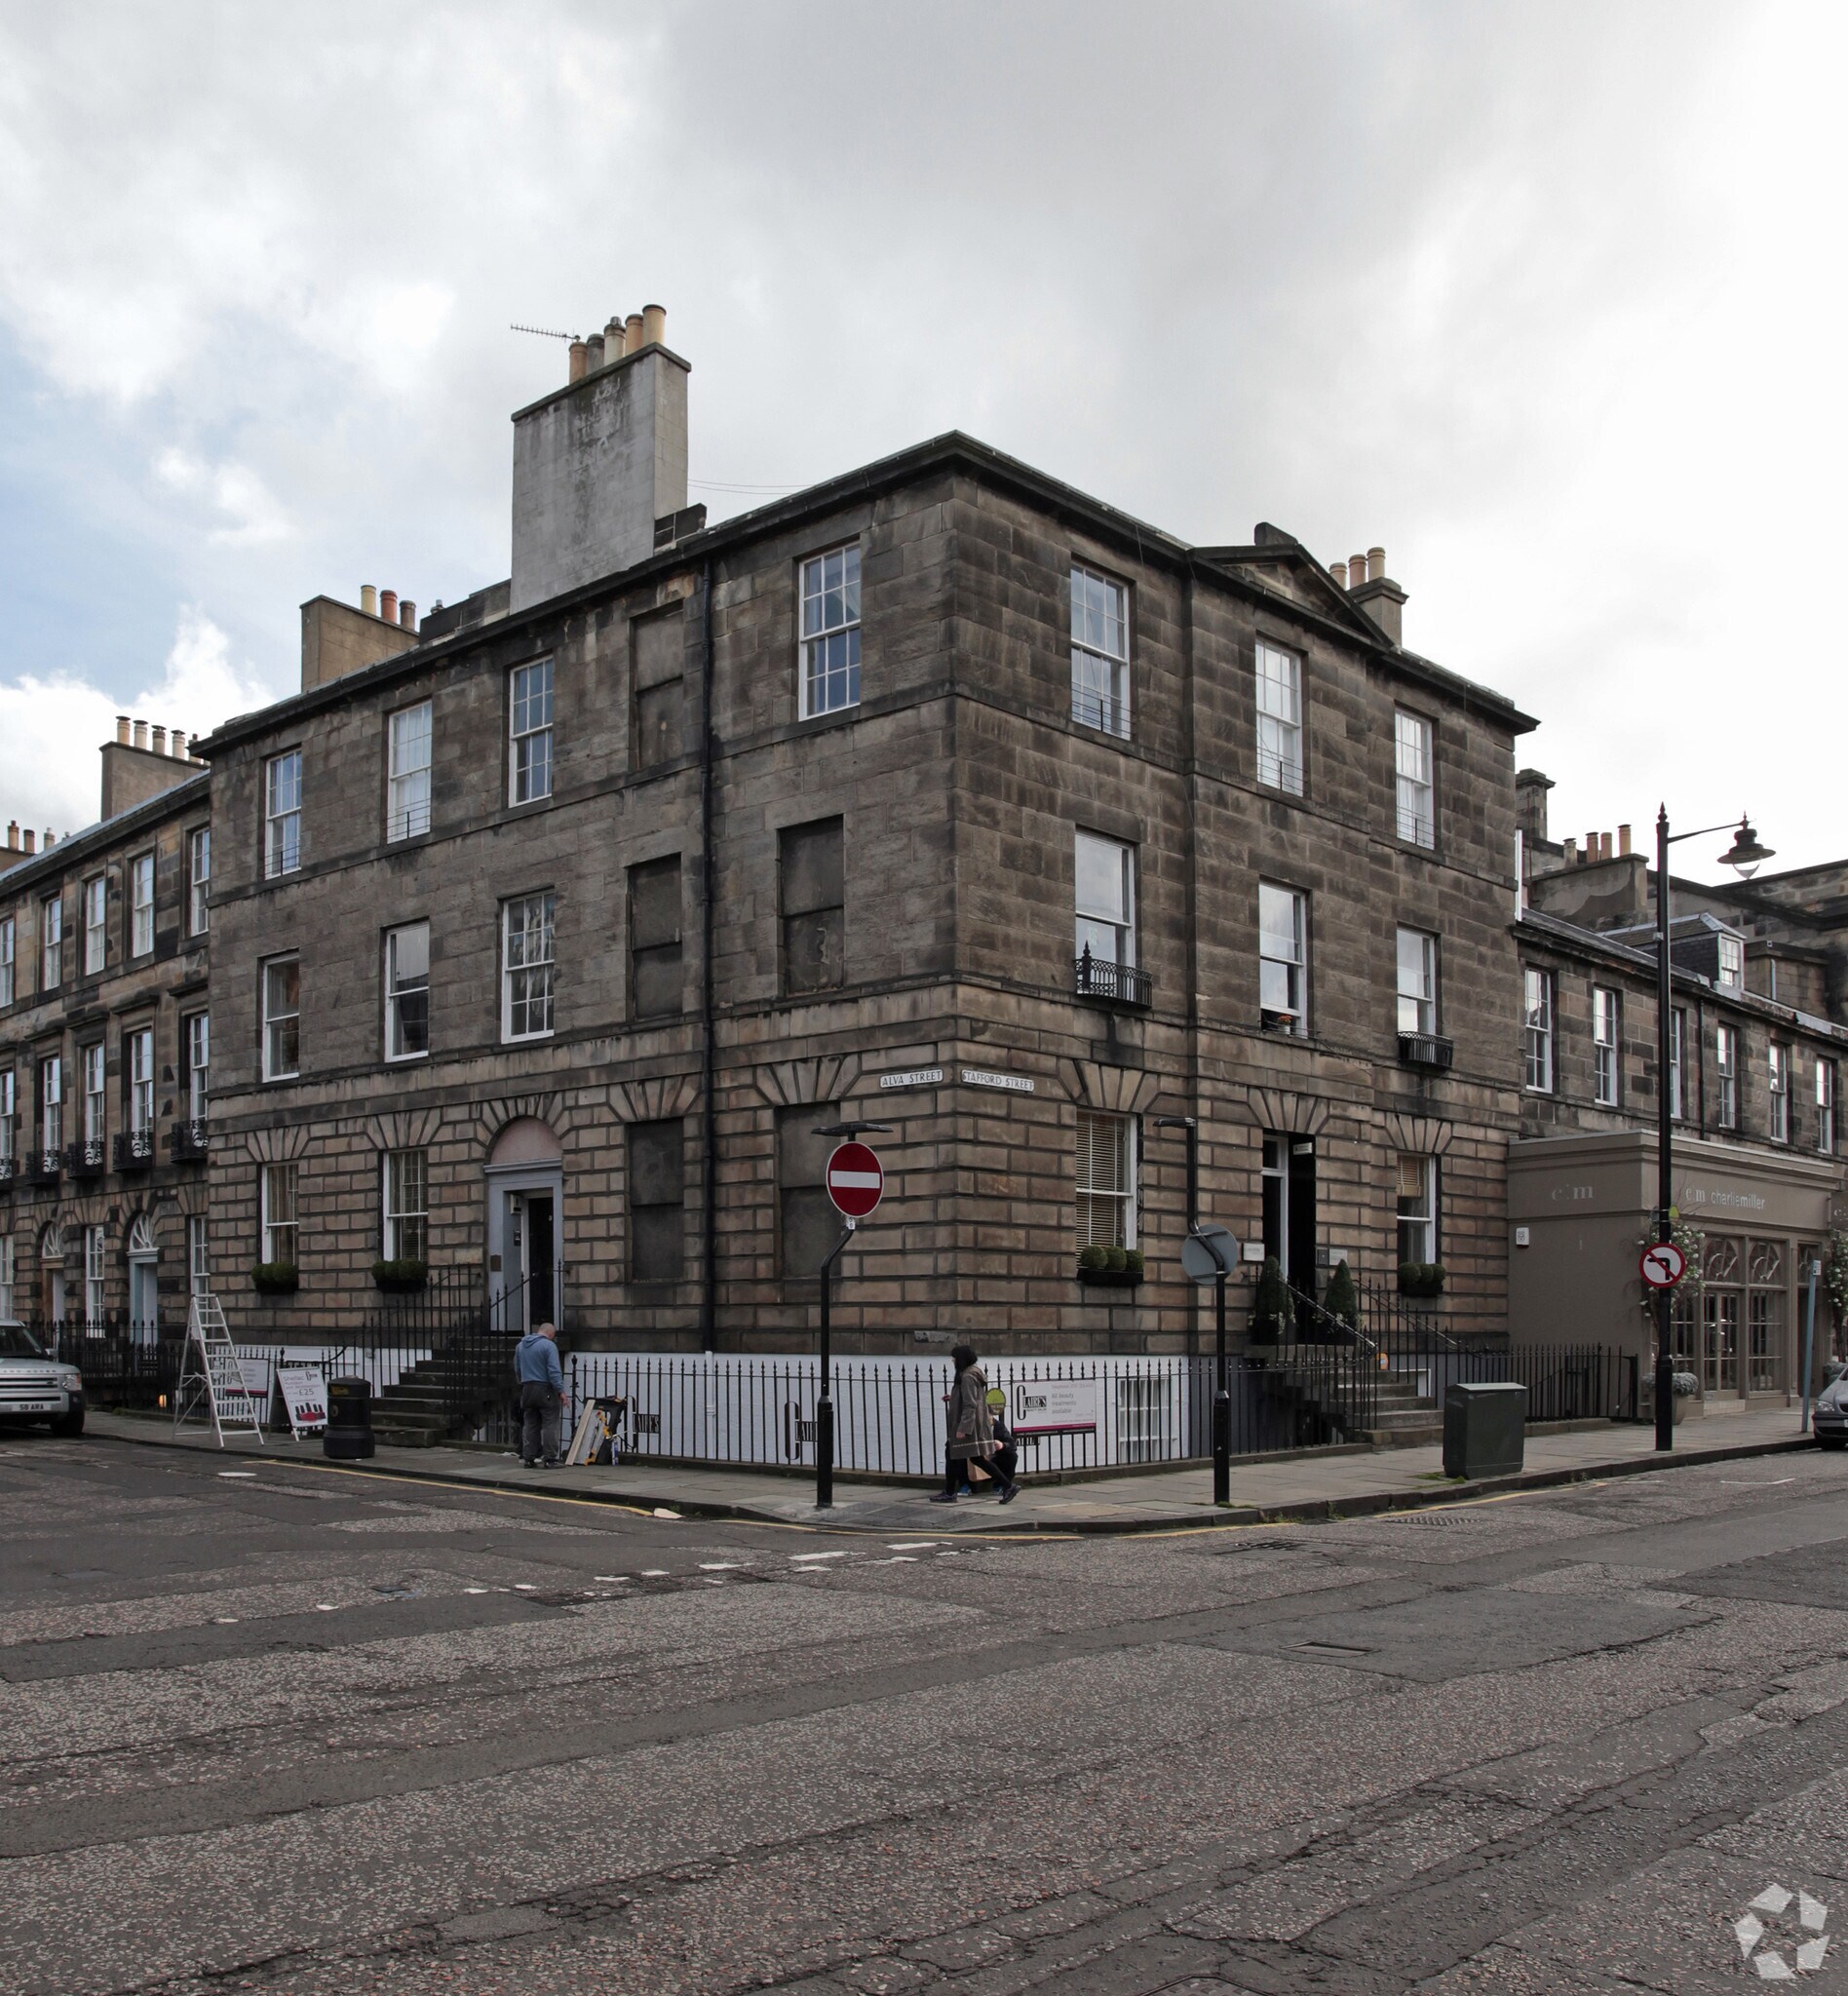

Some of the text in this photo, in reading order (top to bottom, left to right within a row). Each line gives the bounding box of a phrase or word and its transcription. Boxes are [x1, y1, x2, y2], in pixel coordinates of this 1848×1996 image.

[882, 1071, 943, 1086] ALVA STREET
[962, 1071, 1034, 1091] STAFFORD STREET
[1711, 1189, 1766, 1209] charliemiller
